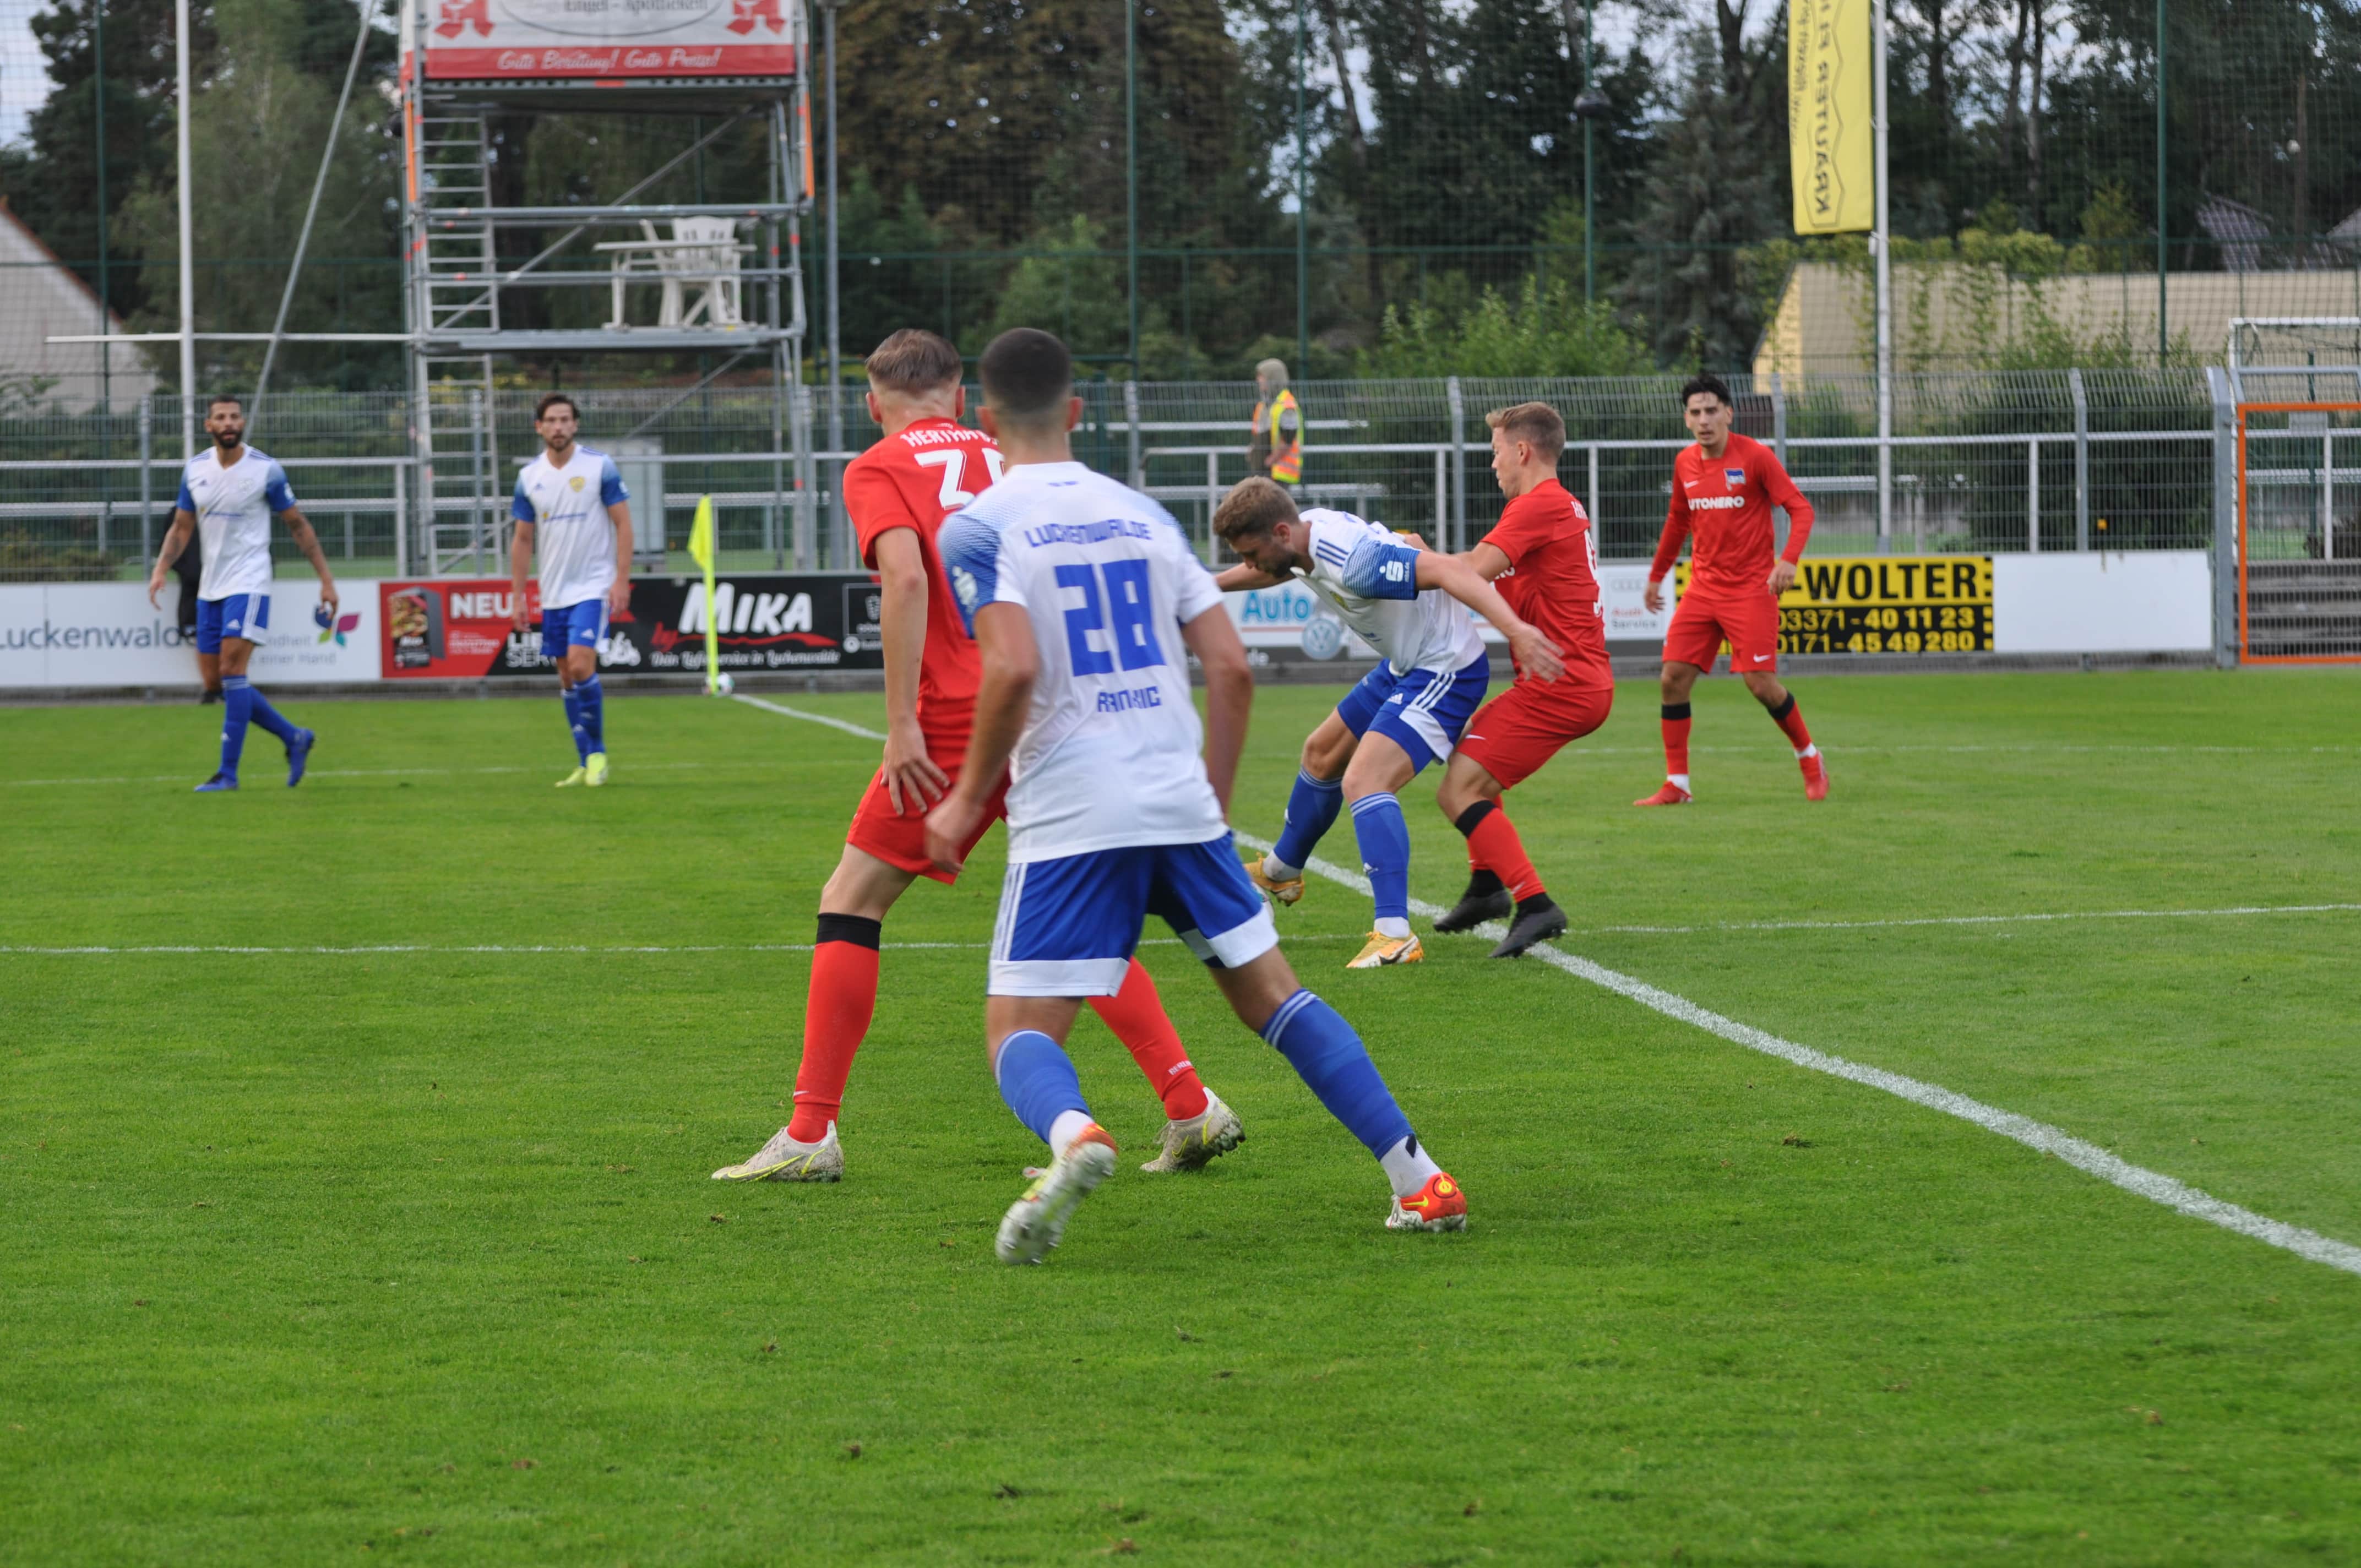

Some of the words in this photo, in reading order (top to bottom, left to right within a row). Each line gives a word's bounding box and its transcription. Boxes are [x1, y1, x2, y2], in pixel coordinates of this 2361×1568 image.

[1688, 496, 1745, 511] UTOHERO
[1792, 564, 1978, 600] -WOLTER
[678, 582, 813, 635] MIKA
[1054, 558, 1167, 677] 28
[1243, 589, 1310, 622] Auto
[1904, 607, 1933, 629] 11
[1939, 607, 1976, 629] 23
[0, 619, 196, 649] uckenwald
[1886, 631, 1922, 653] 49
[1925, 630, 1976, 652] 280
